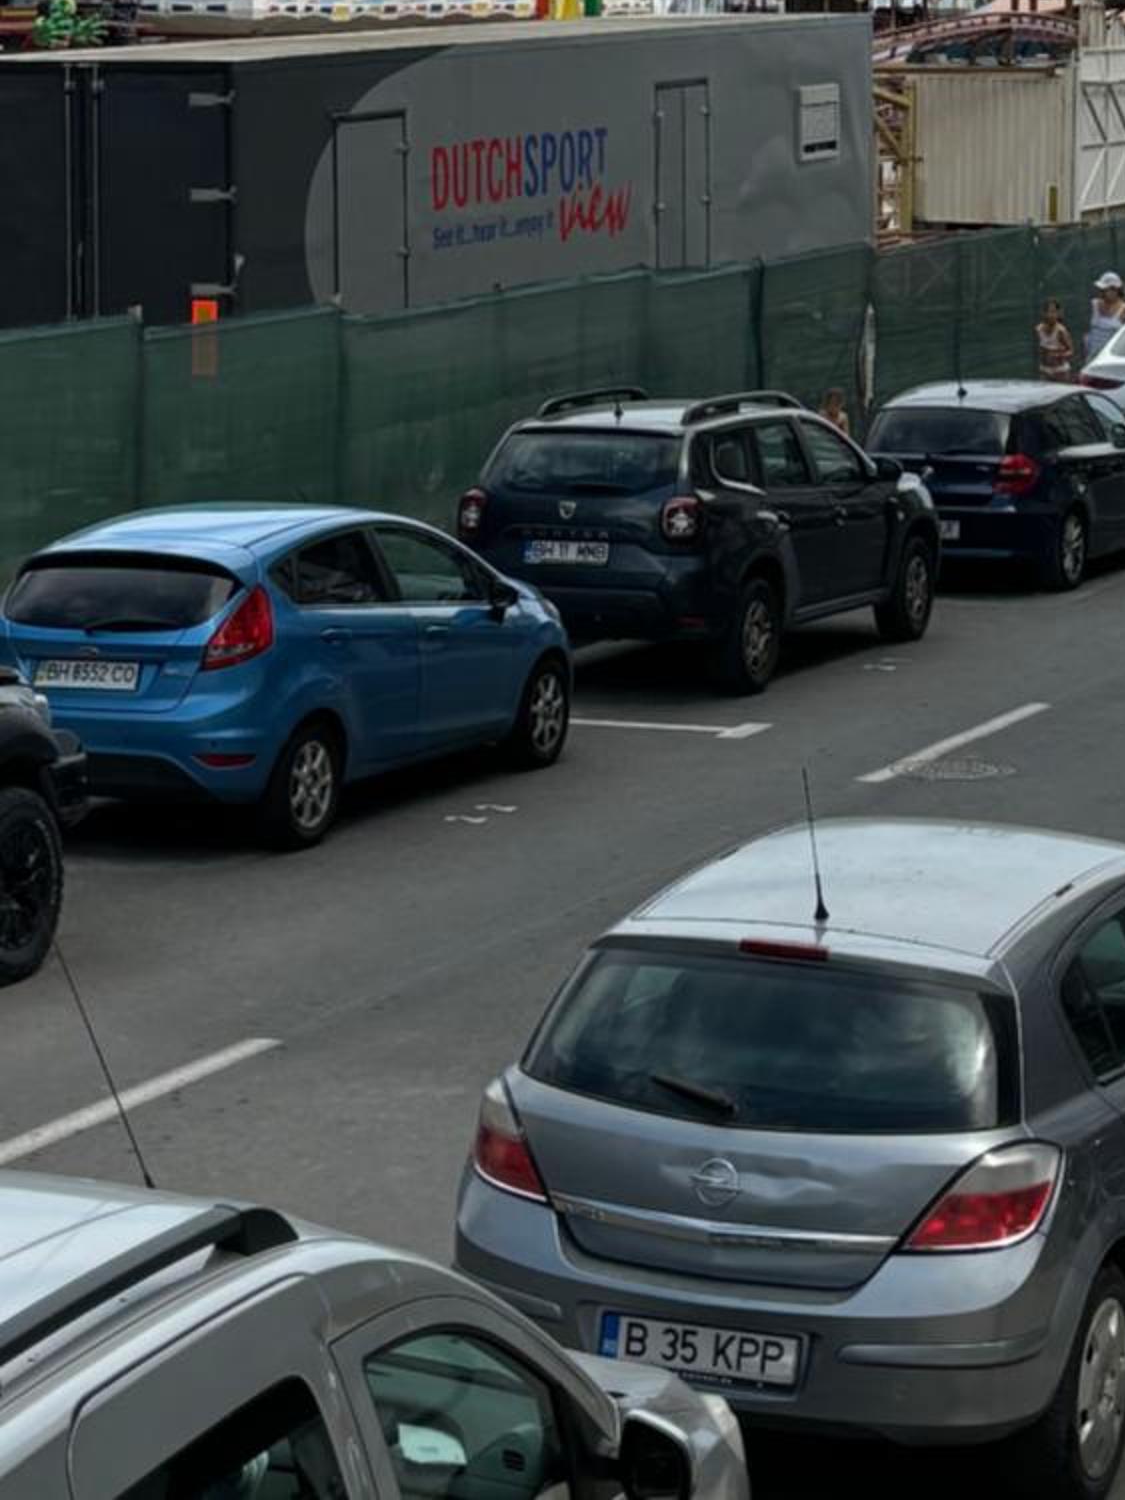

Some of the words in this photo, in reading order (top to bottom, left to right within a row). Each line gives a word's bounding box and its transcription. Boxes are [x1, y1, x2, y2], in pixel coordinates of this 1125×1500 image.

[432, 127, 607, 211] DUTCHSPORT
[47, 661, 71, 679] BH
[111, 664, 136, 683] CO
[624, 1321, 648, 1357] B
[660, 1328, 698, 1364] 35
[711, 1332, 785, 1374] KPP
